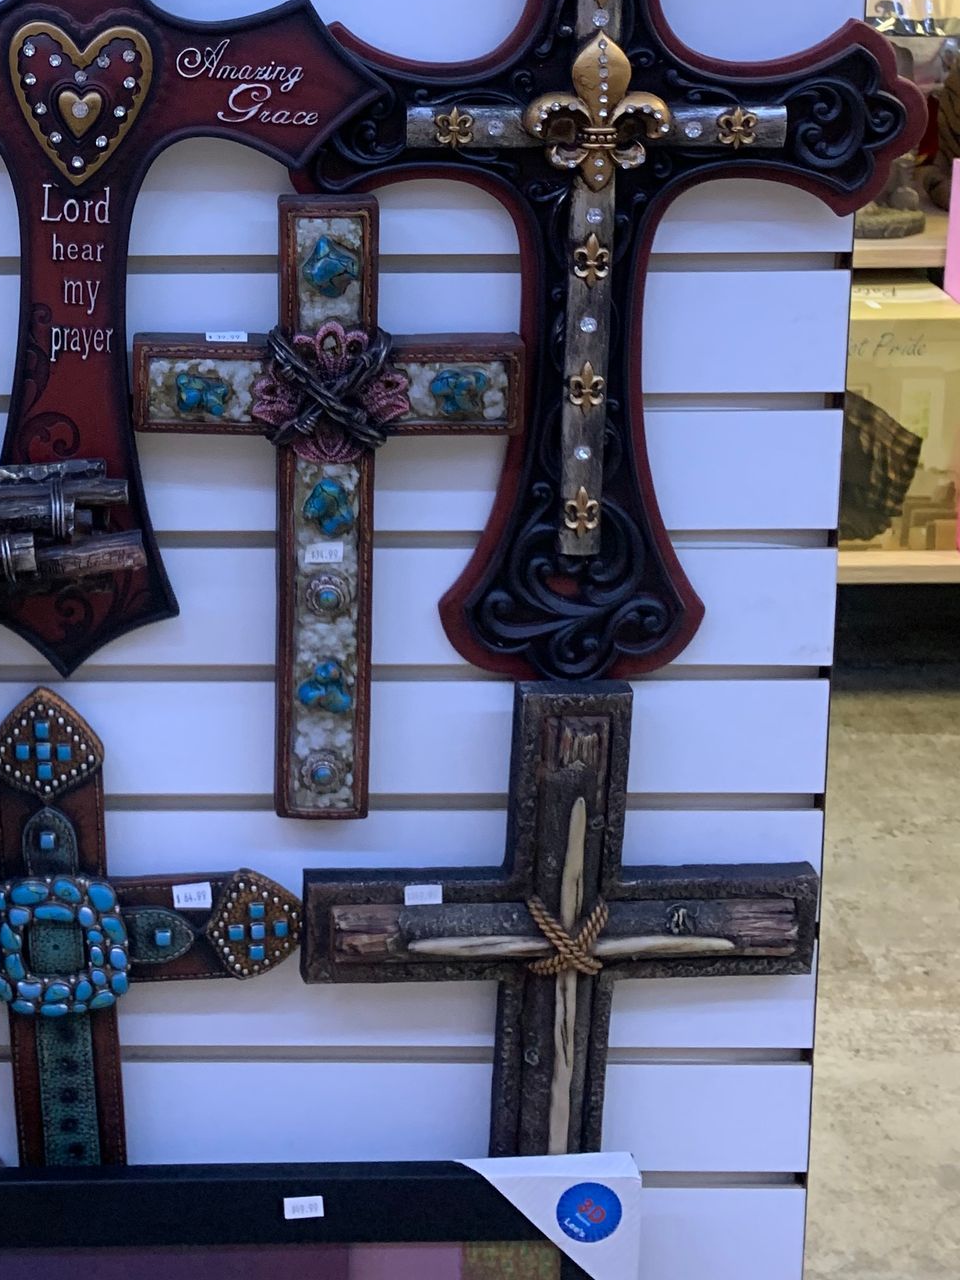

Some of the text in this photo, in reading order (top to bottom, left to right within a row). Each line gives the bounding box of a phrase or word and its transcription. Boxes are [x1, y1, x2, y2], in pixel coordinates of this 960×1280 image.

[176, 39, 304, 93] Amazing
[217, 83, 320, 127] Grace
[40, 184, 111, 224] Lord
[51, 233, 105, 262] hear
[63, 278, 101, 315] my
[49, 326, 114, 362] prayer
